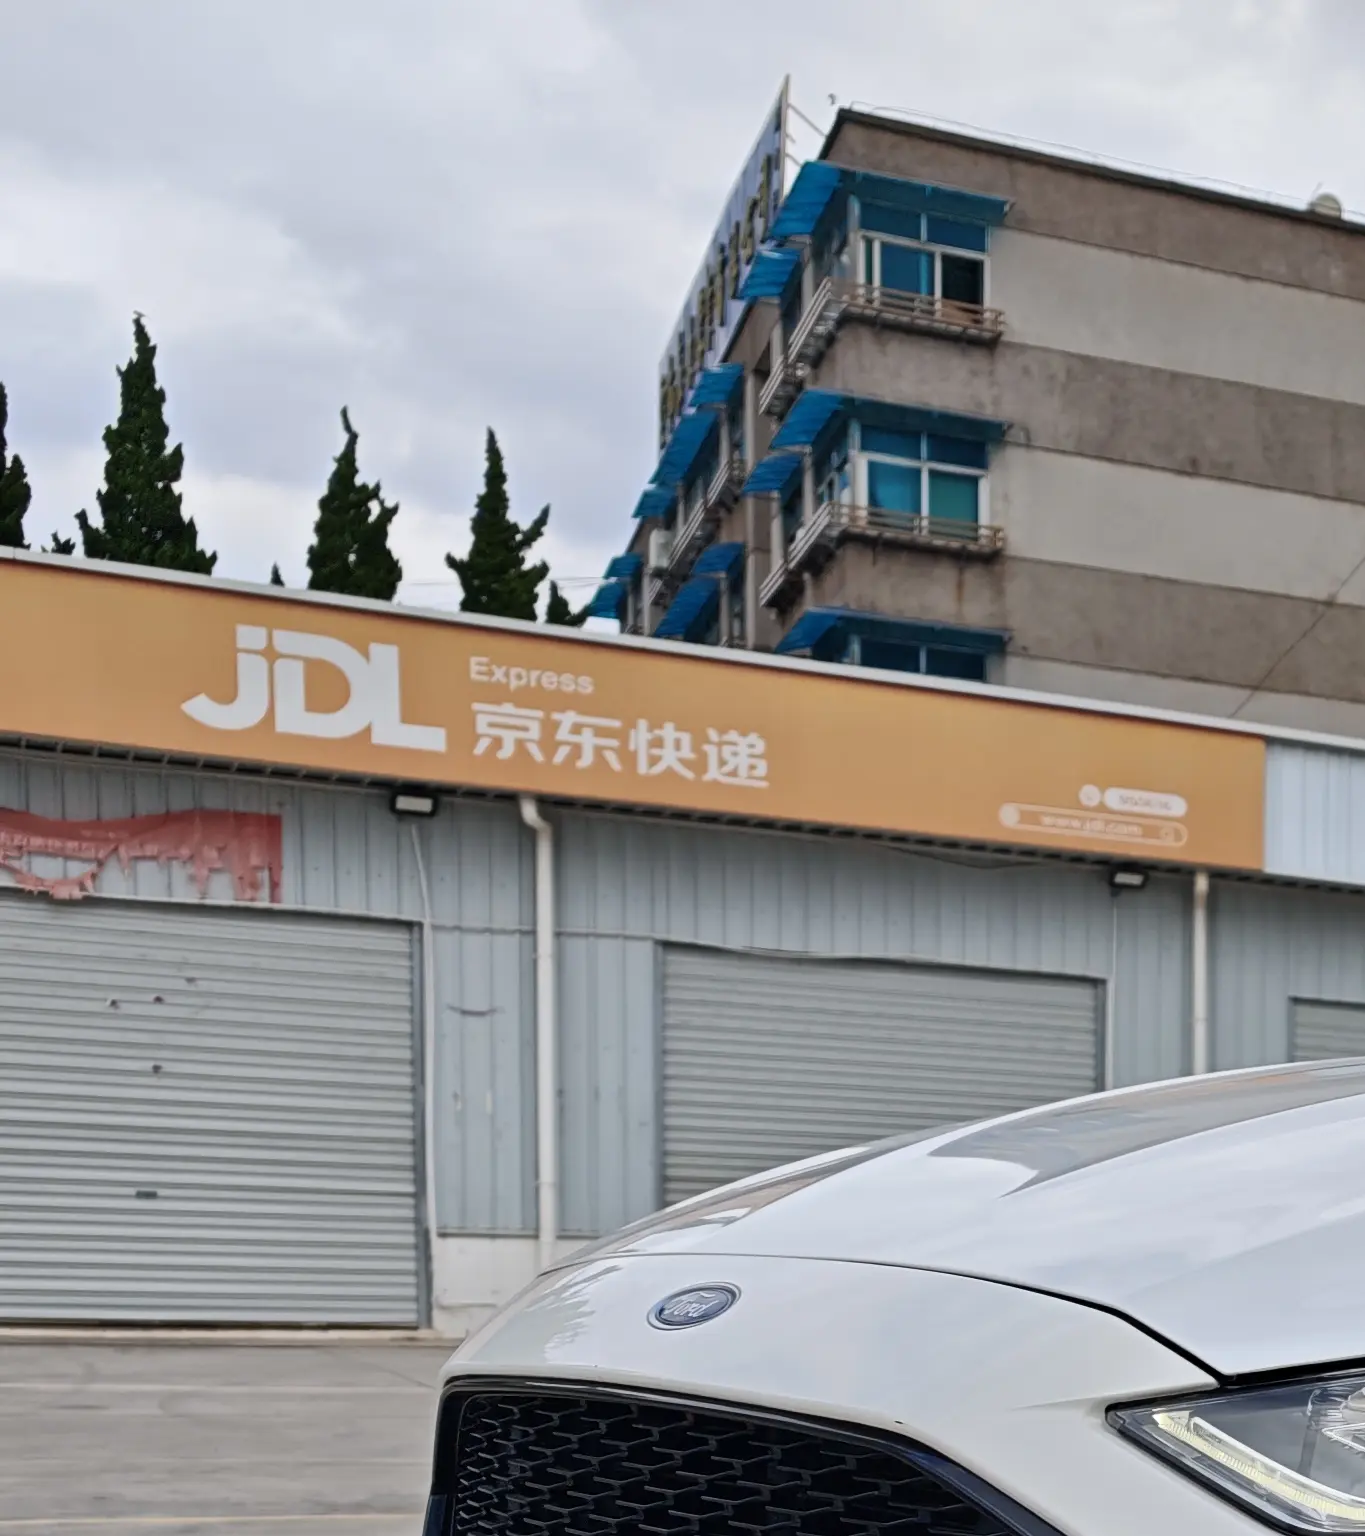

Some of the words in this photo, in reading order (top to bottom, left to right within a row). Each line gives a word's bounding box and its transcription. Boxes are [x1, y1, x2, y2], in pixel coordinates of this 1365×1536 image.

[469, 656, 595, 694] Express
[470, 702, 770, 788] 京东快递
